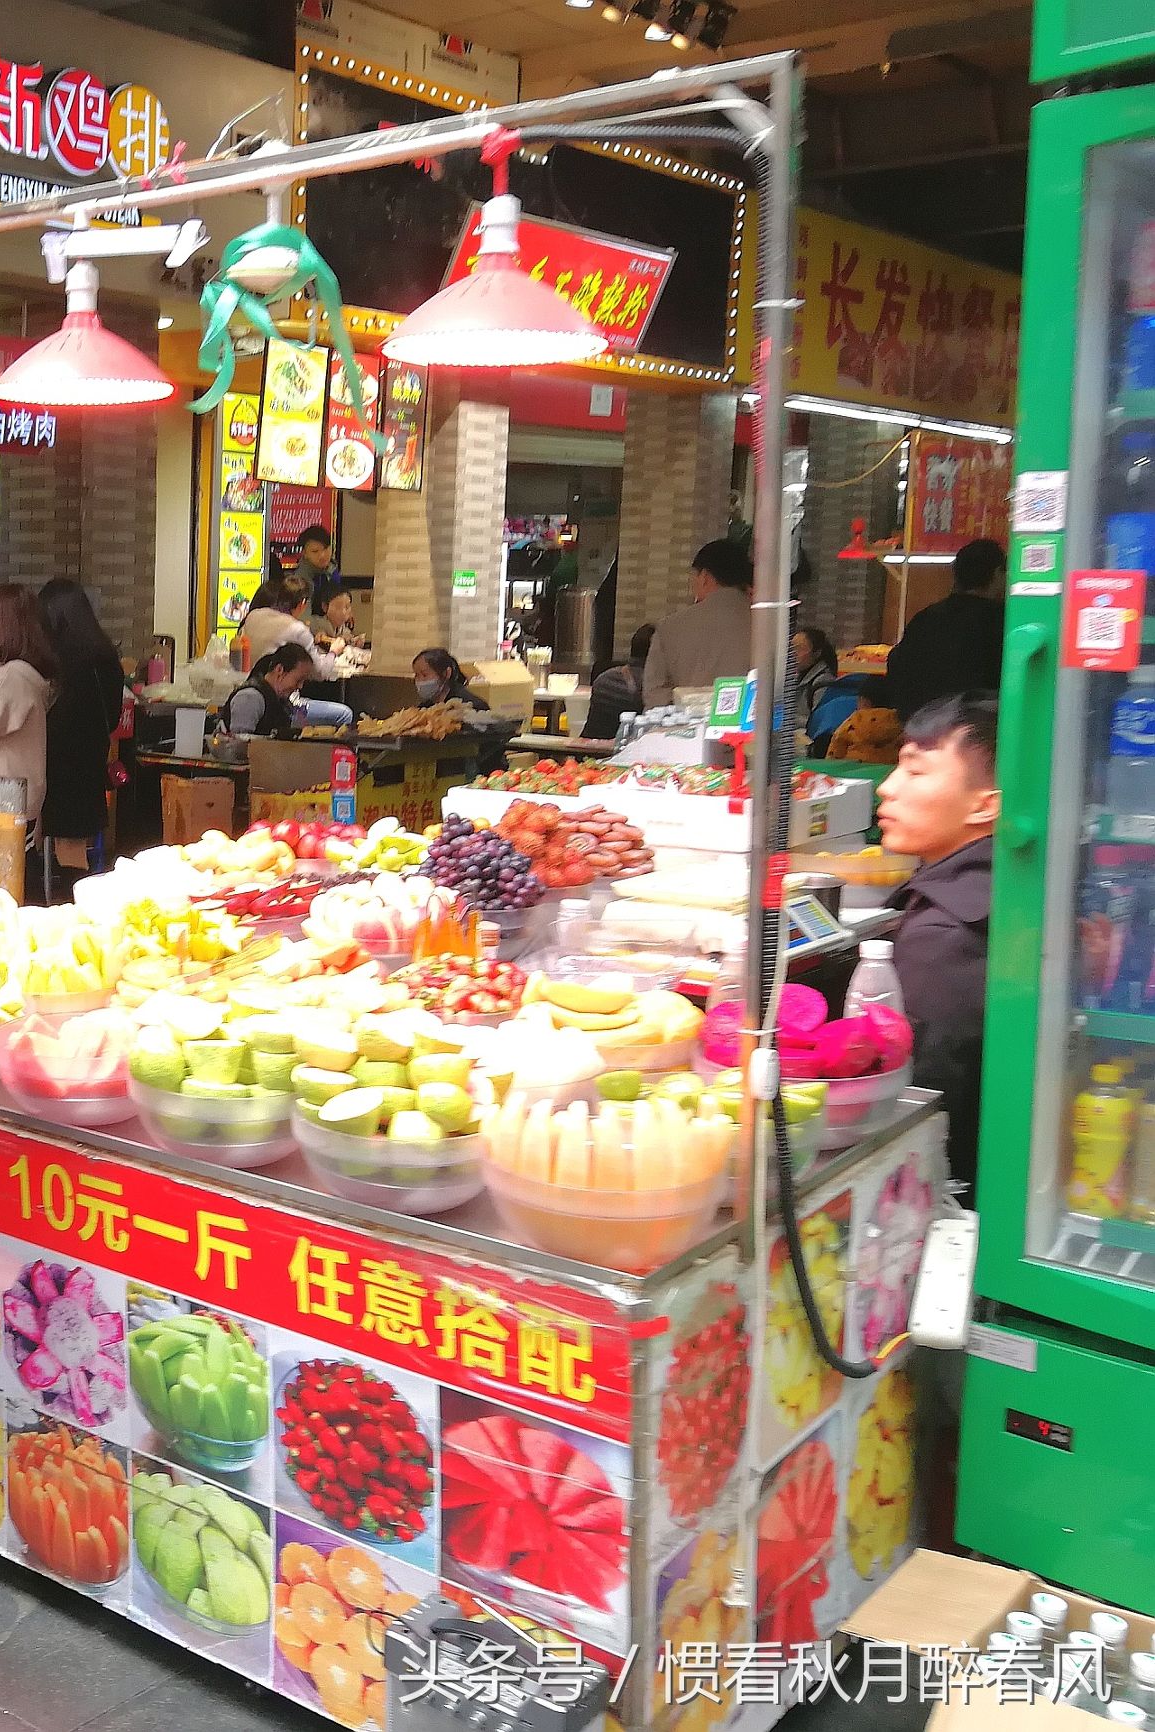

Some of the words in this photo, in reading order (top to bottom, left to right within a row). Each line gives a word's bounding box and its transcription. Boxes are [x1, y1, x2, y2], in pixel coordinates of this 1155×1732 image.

[8, 1154, 253, 1291] 10元一斤
[287, 1235, 597, 1403] 任意搭配
